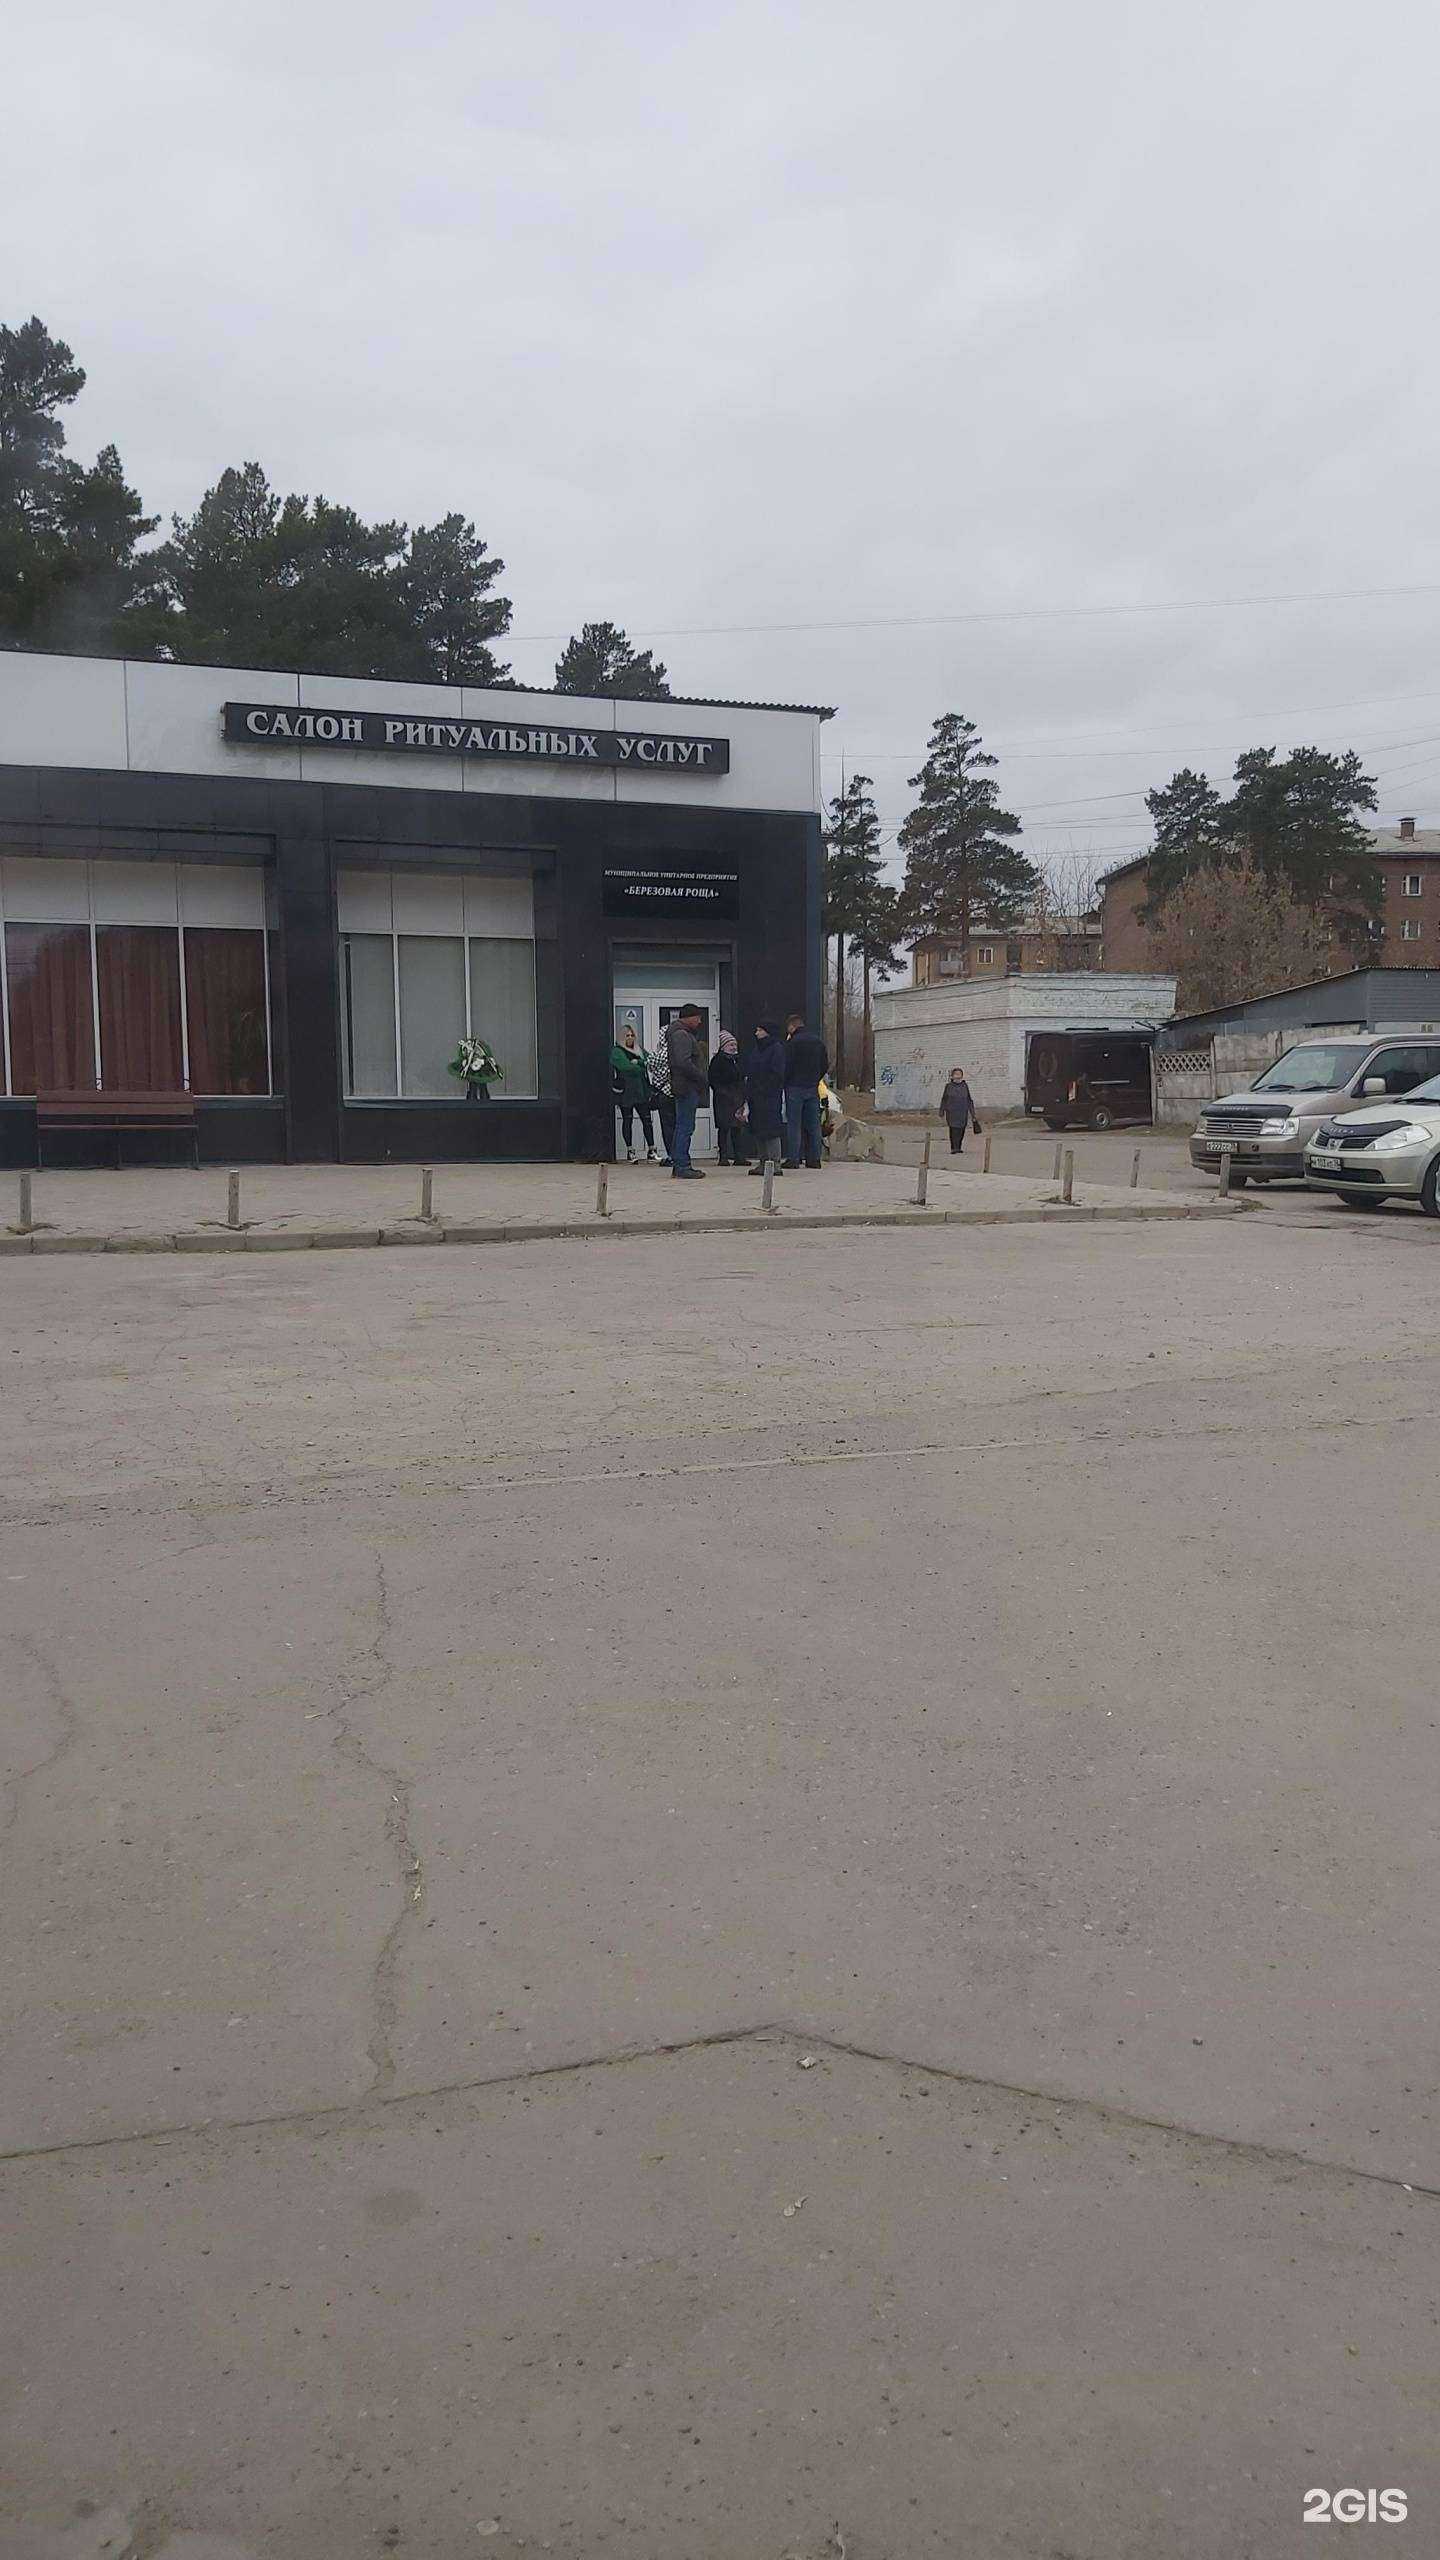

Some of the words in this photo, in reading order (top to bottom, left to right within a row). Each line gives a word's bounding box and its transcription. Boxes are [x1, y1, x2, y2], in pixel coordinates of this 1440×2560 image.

[246, 710, 364, 742] САЛОН
[384, 720, 599, 757] РИТУАЛЬНЫХ
[618, 737, 713, 765] УСЛУГ
[624, 886, 683, 897] «БЕРЕЗОВАЯ
[685, 888, 719, 899] РОЩА»
